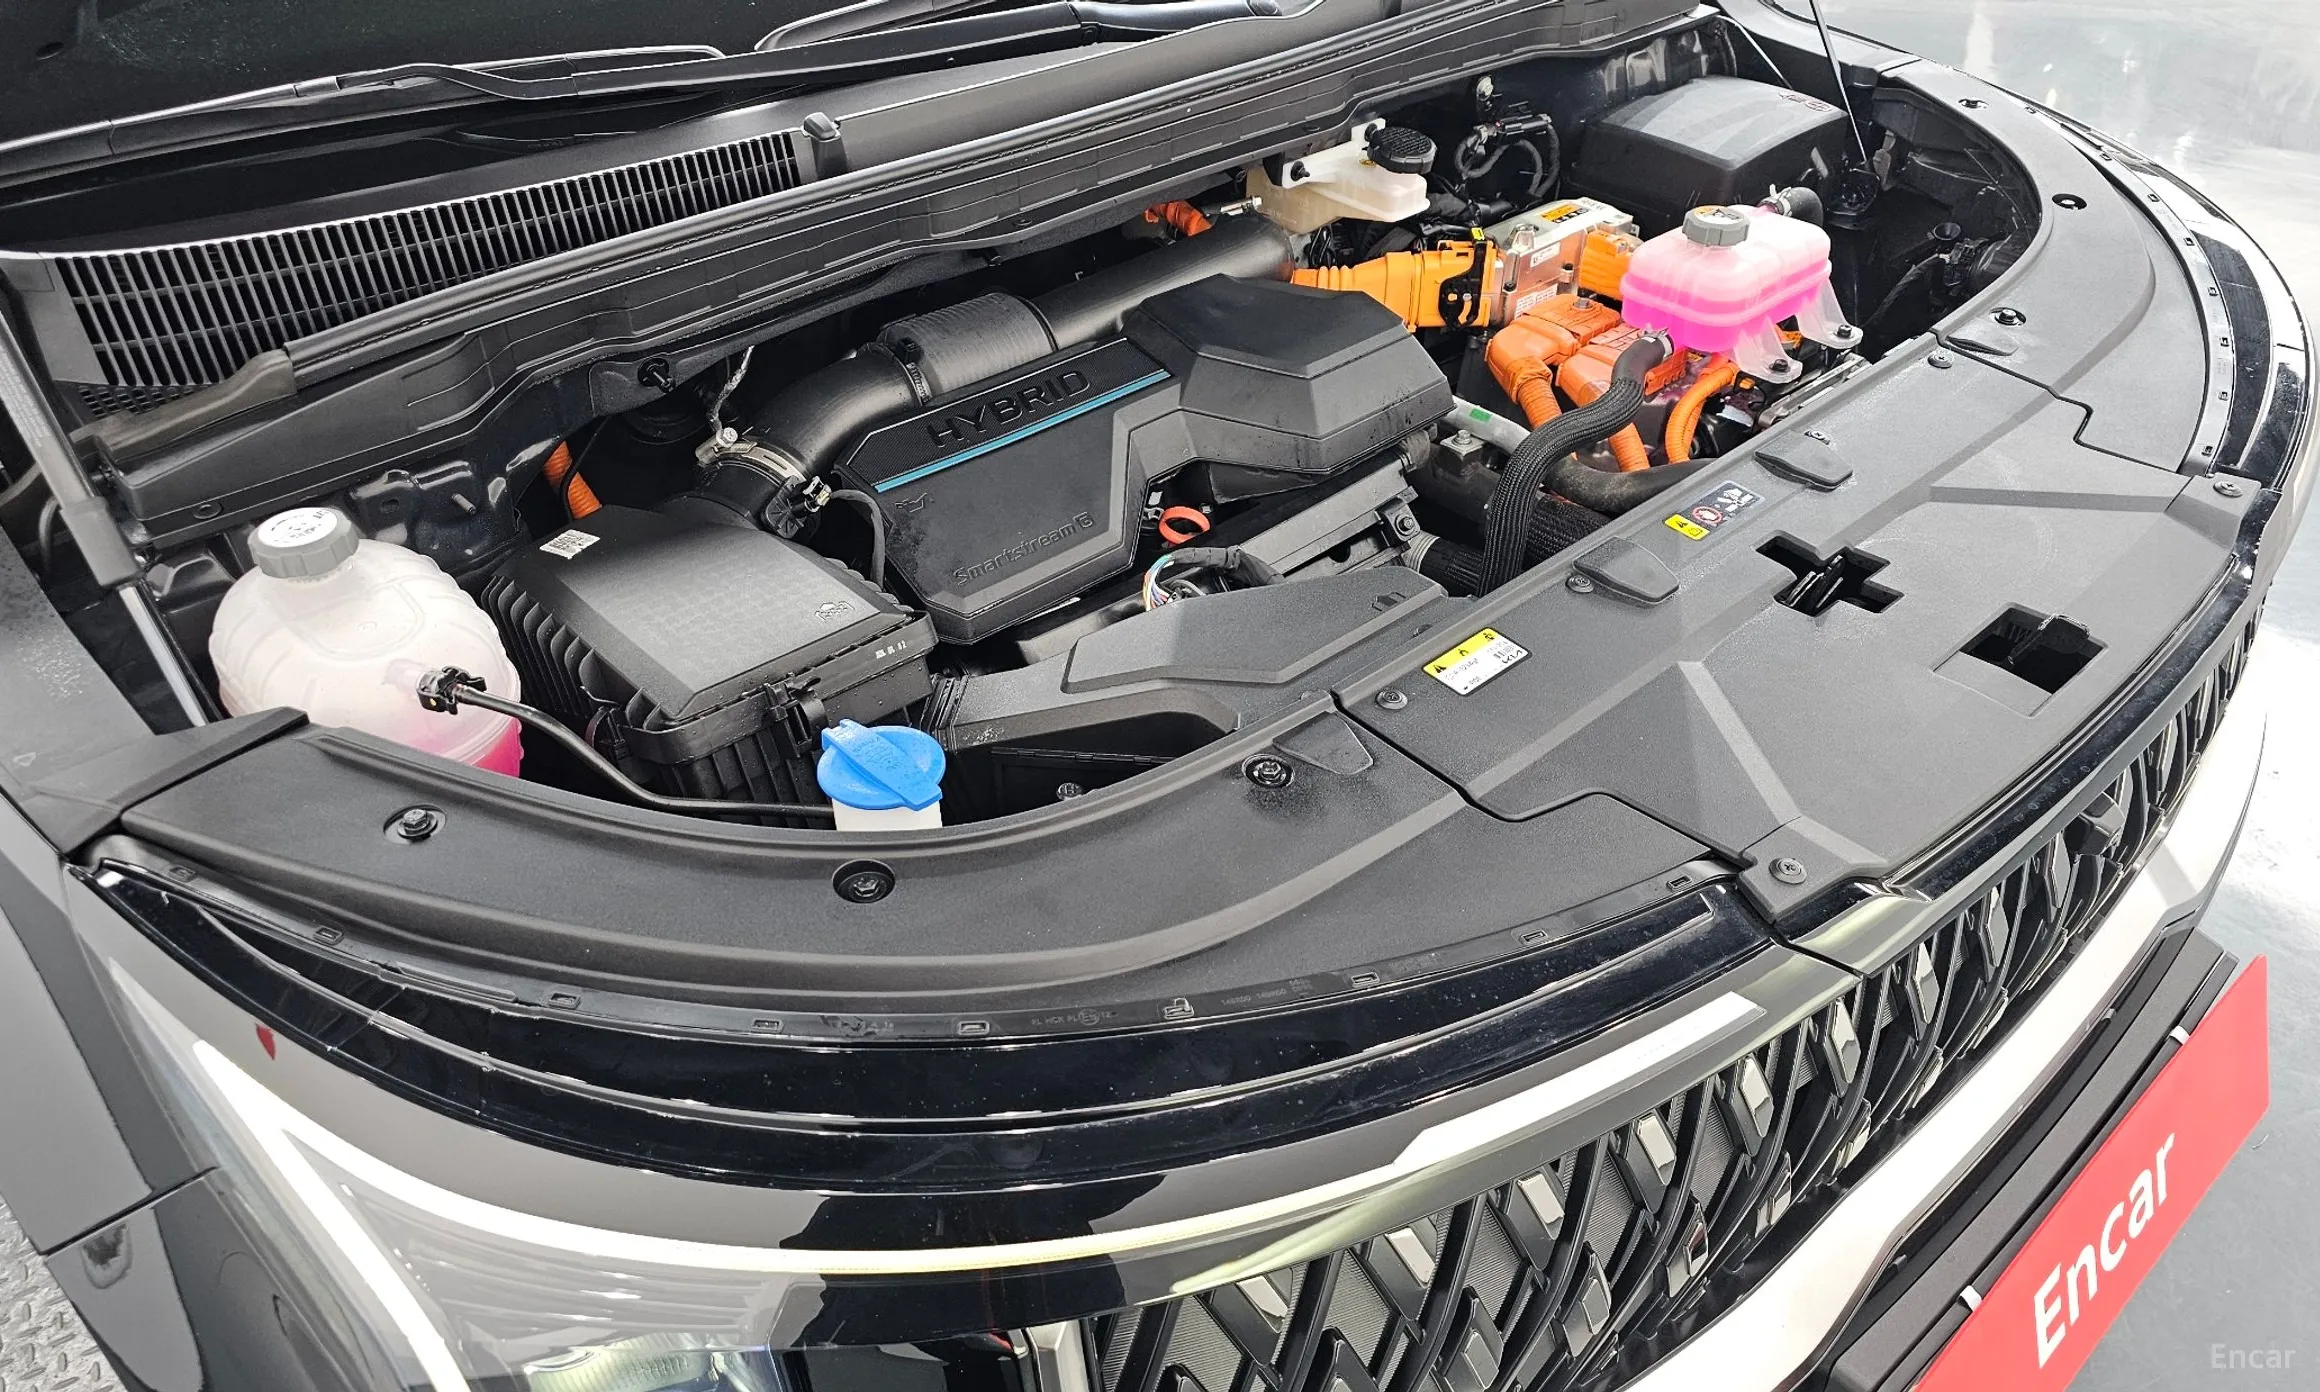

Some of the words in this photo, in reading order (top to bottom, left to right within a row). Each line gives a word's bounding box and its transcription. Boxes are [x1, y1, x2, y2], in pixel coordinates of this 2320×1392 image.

[926, 370, 1091, 448] HYBRID
[953, 522, 1077, 586] Smartstream
[2034, 1132, 2175, 1369] Encar
